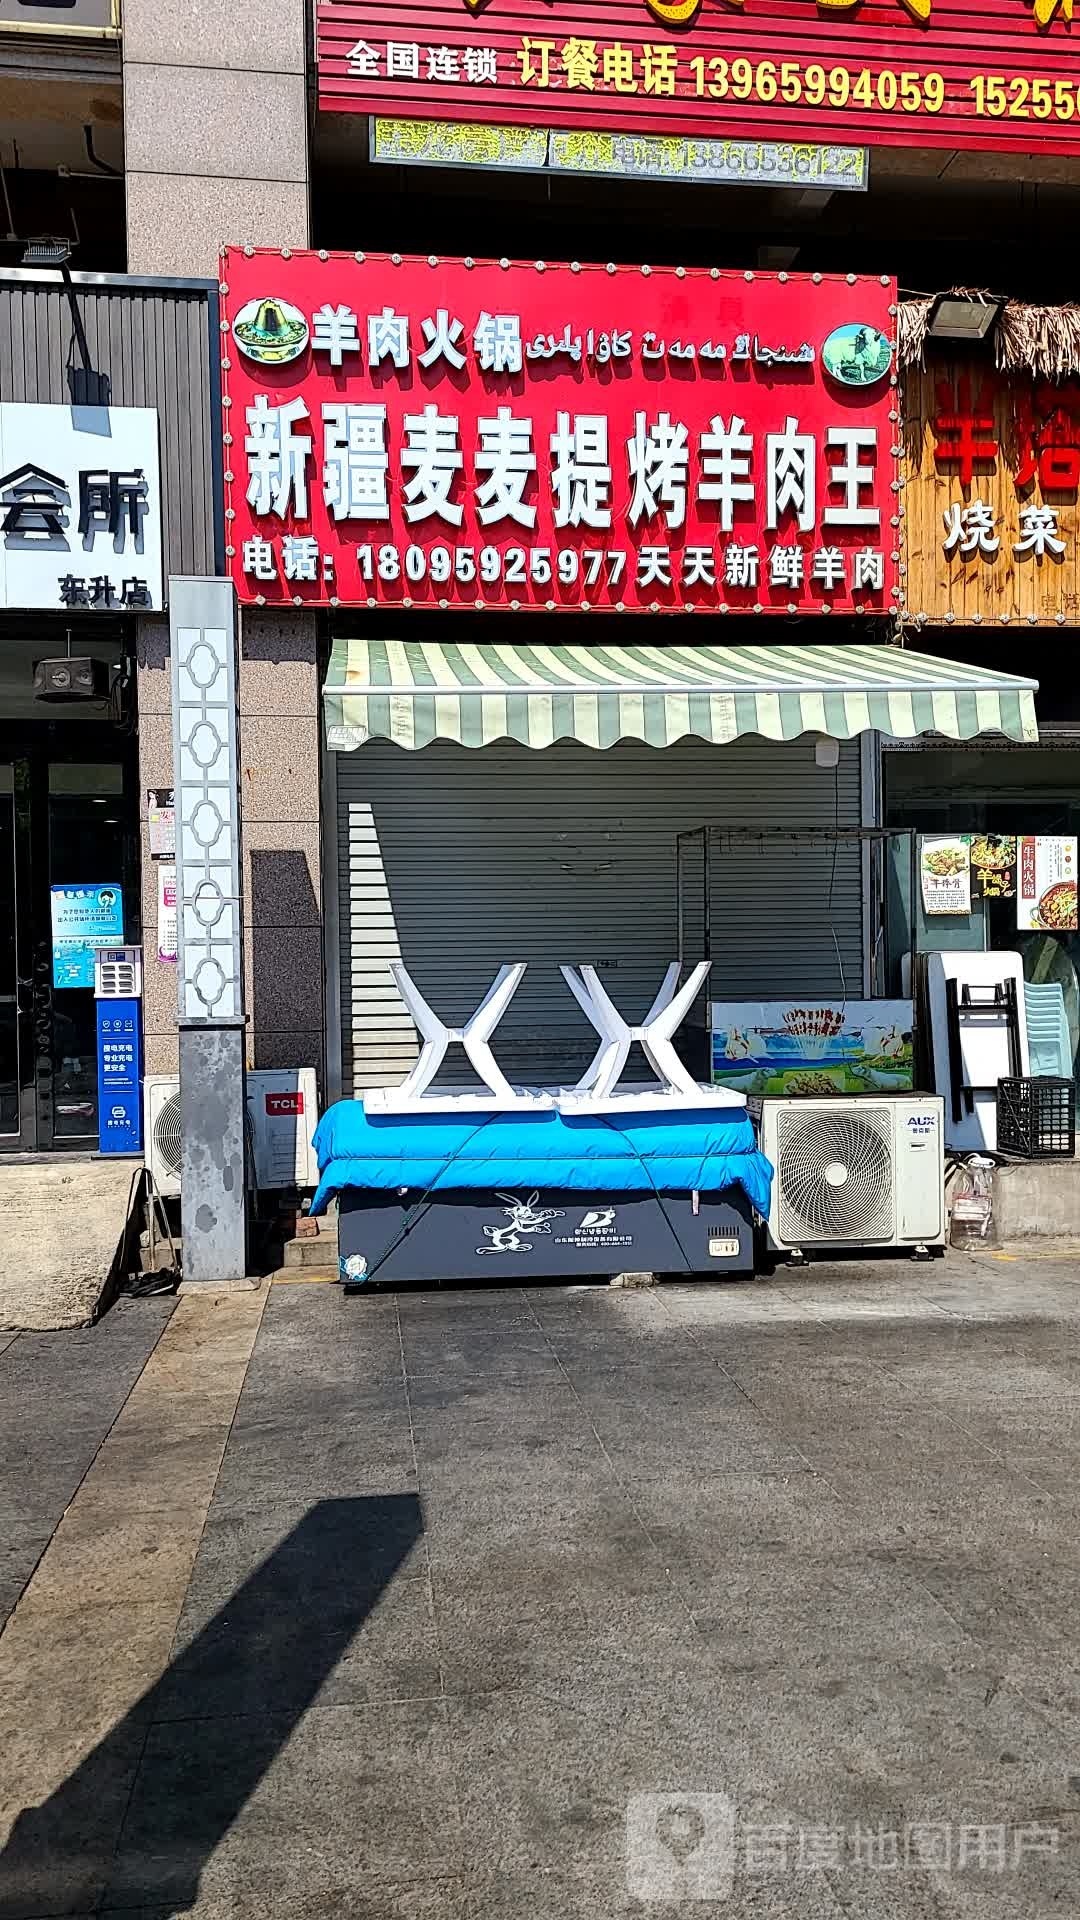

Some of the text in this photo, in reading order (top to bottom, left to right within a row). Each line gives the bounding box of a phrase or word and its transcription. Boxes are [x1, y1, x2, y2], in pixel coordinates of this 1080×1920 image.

[345, 37, 1080, 120] 全国连锁 订餐电话 13965994059 15255
[311, 303, 523, 373] 羊肉火锅
[244, 394, 880, 533] 新疆麦麦提烤羊肉王
[0, 463, 145, 535] 会所
[942, 500, 1067, 555] 烧菜
[57, 574, 149, 606] 东升店
[357, 544, 627, 586] 18095925977
[637, 543, 885, 591] 天天新鲜羊肉
[1023, 845, 1035, 896] 牛肉火锅
[103, 1063, 126, 1072] 更安全
[271, 1099, 299, 1109] TCL
[907, 1116, 936, 1126] AUX
